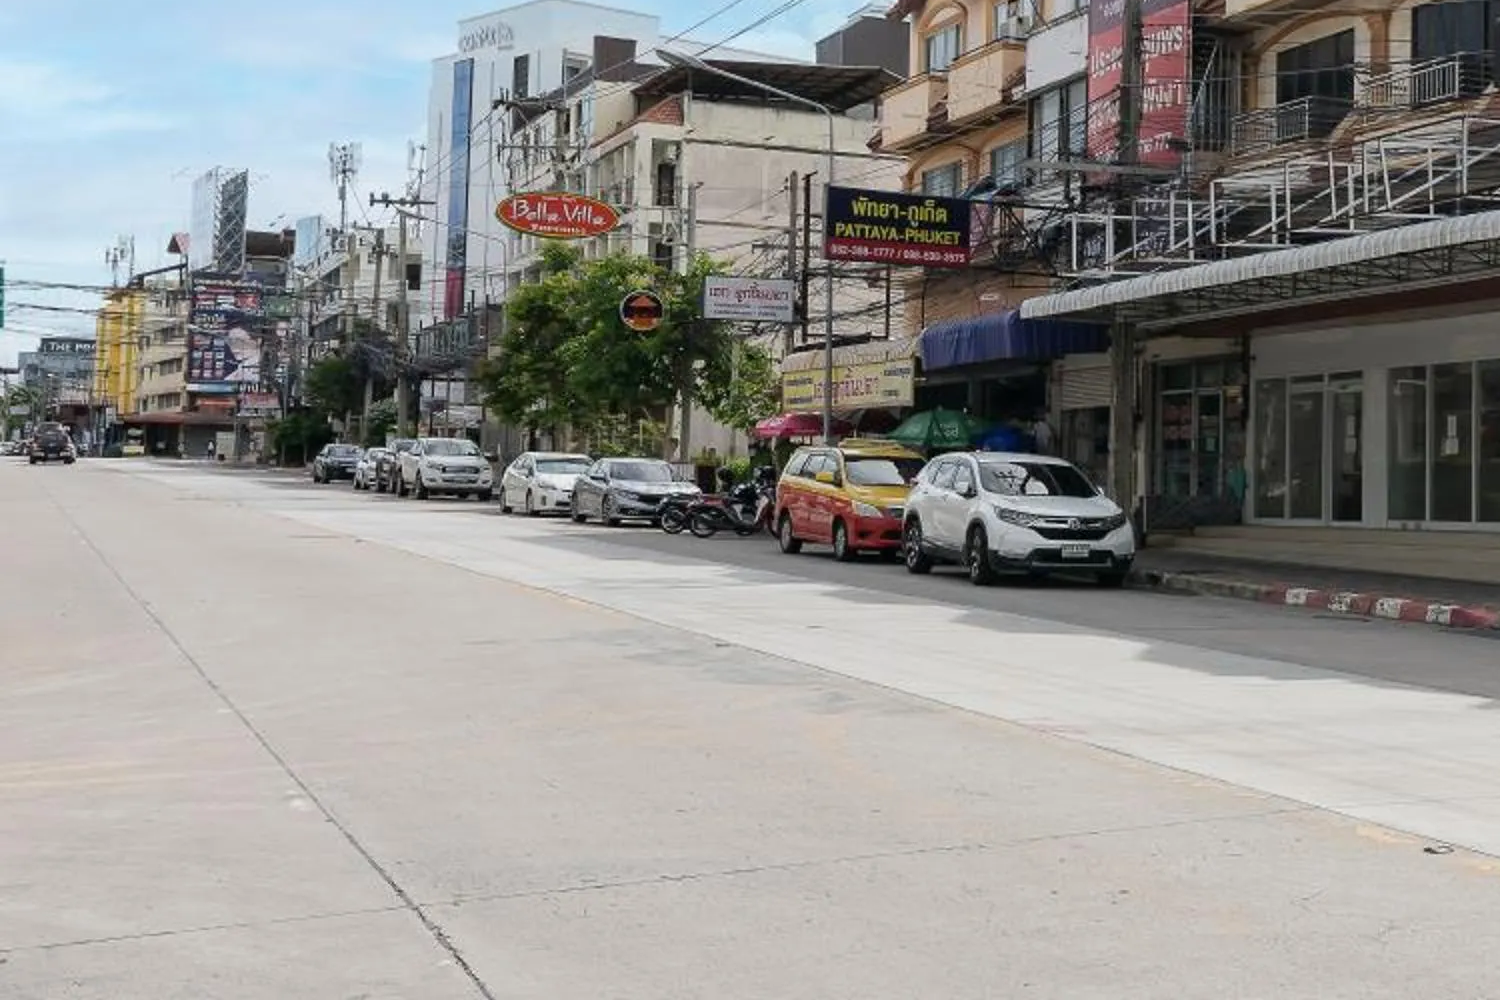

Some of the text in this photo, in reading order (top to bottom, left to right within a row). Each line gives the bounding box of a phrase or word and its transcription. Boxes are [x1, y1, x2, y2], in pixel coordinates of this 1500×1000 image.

[510, 199, 606, 225] Bella Villa
[834, 221, 960, 245] PATTAYA-PHUKET
